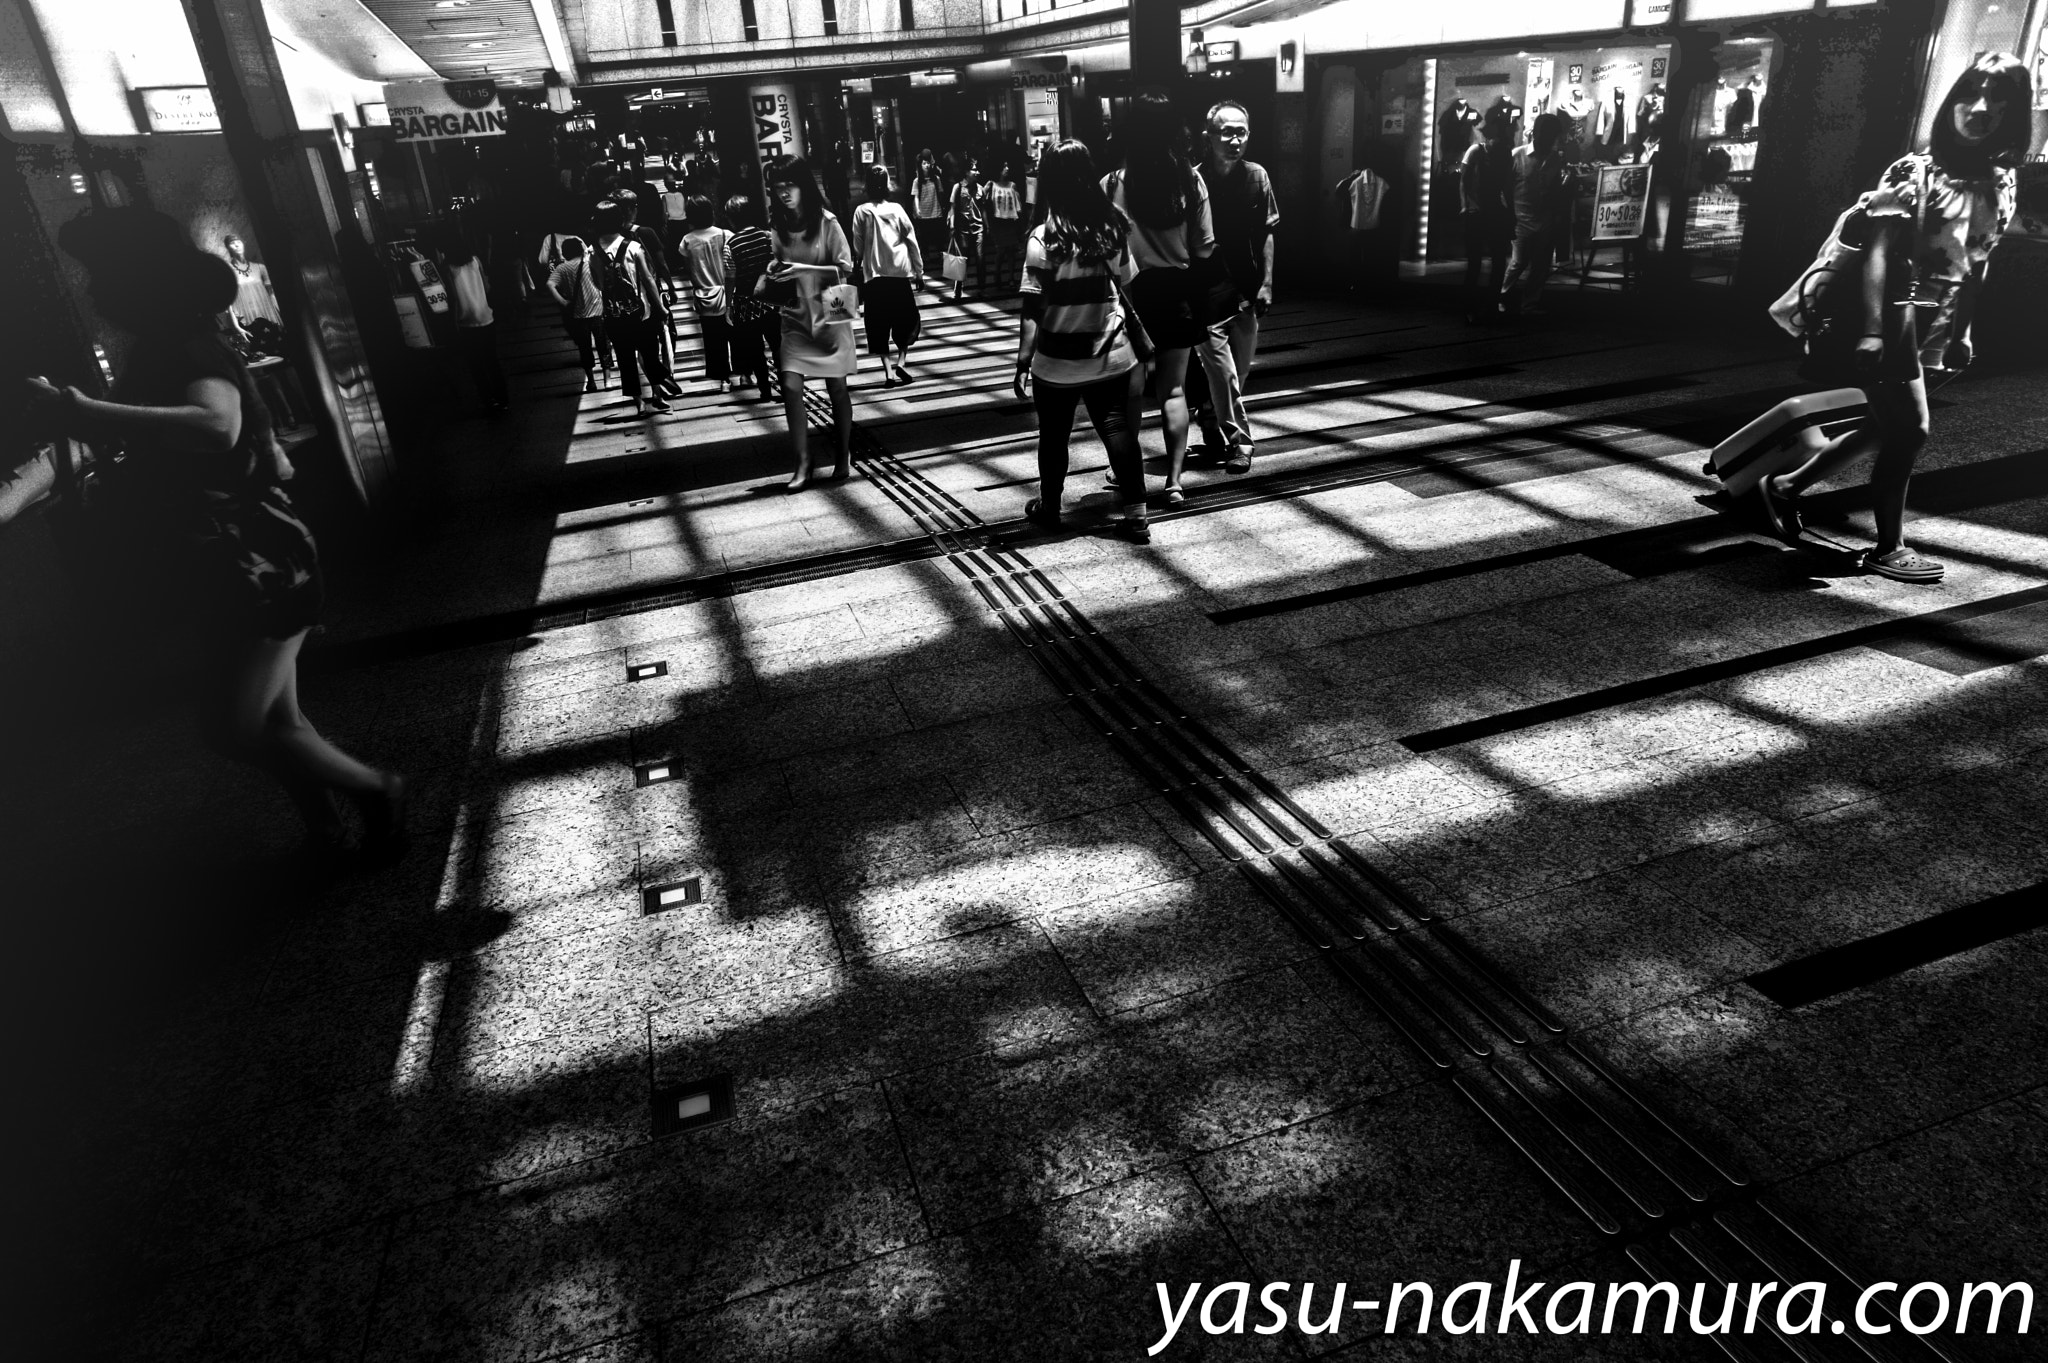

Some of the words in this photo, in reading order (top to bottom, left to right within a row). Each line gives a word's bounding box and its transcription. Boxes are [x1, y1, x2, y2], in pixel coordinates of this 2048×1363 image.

[1570, 65, 1581, 76] 30
[1653, 60, 1664, 70] 30
[1011, 72, 1071, 88] BARGAIN
[388, 106, 425, 117] CRYSTA
[391, 110, 506, 139] BARGAIN
[777, 94, 793, 145] CRYSTA
